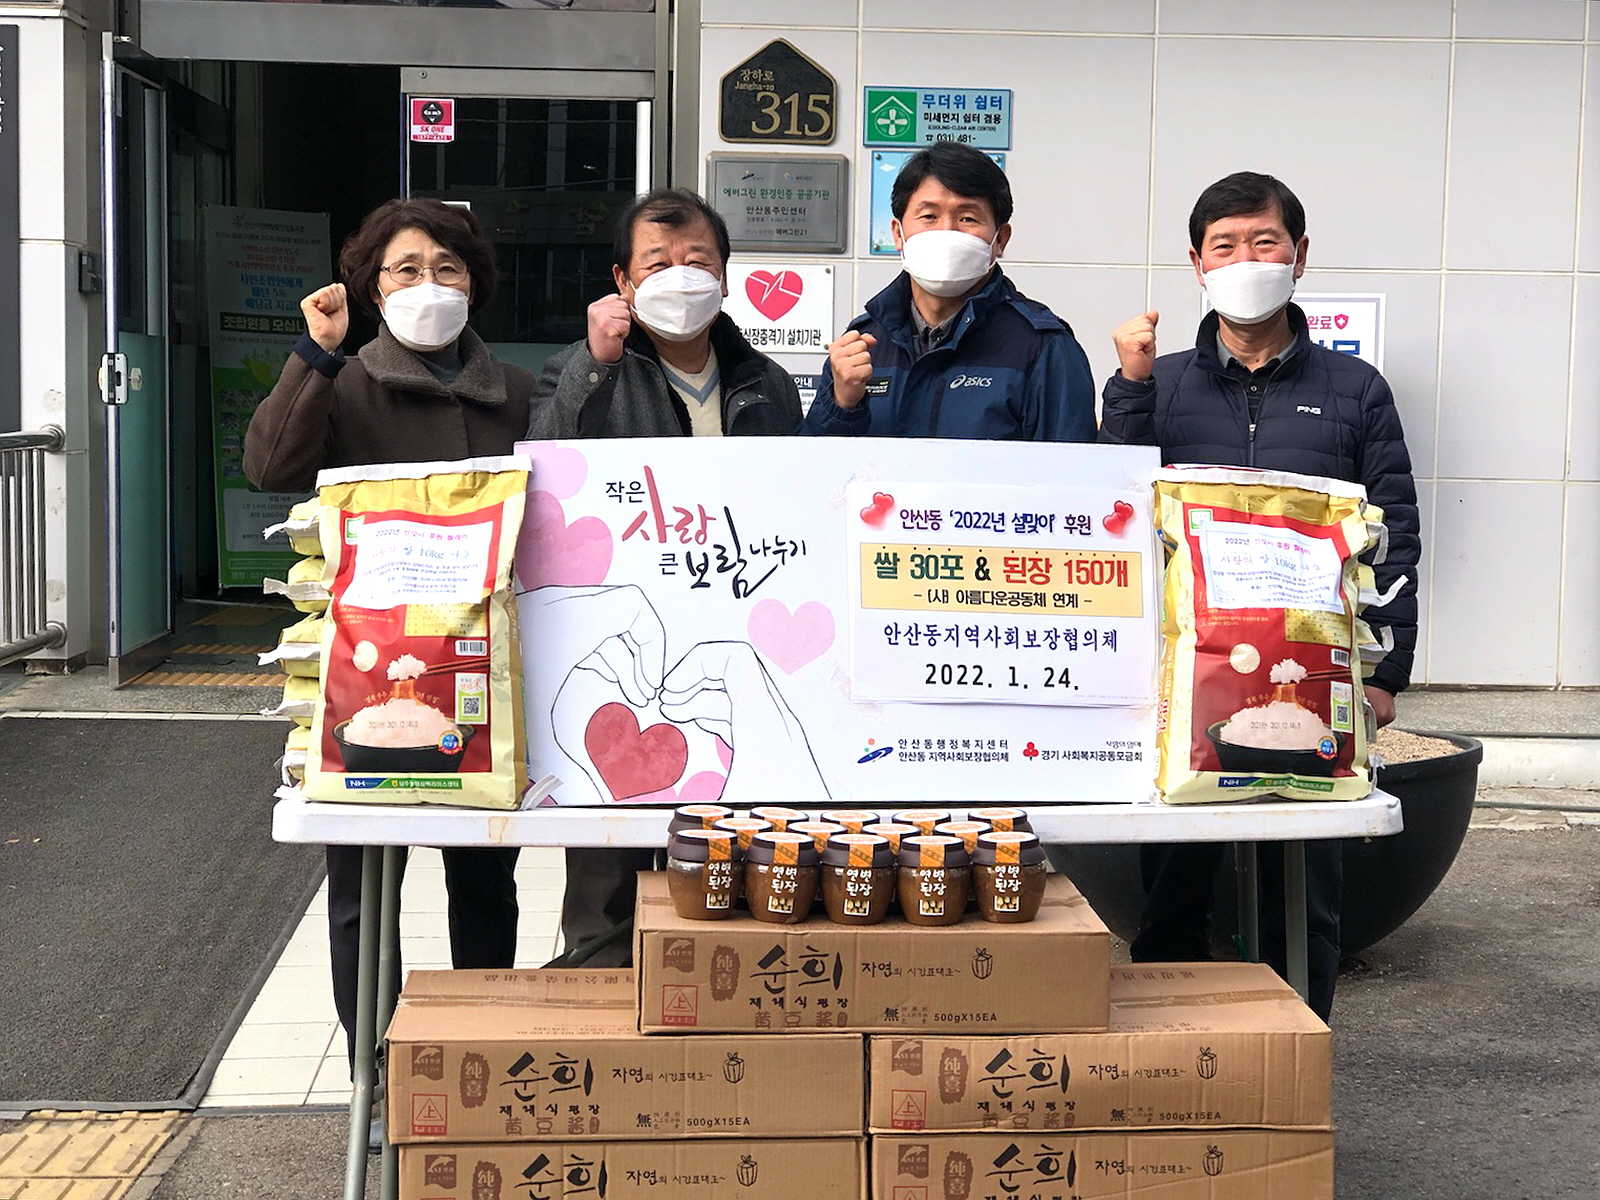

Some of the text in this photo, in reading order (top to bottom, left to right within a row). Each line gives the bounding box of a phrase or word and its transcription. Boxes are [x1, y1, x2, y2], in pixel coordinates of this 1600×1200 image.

[740, 69, 774, 82] 장하로
[922, 94, 1002, 110] 무더위 쉼터
[752, 92, 831, 136] 315
[924, 112, 1002, 124] 미세먼지 쉼터 겸용
[937, 133, 954, 142] 031)
[723, 188, 830, 200] 에버그린 환경인증 공공기관
[746, 206, 806, 216] 안산동주민센터
[224, 316, 270, 331] 조합원을
[788, 328, 822, 346] 설치기관
[606, 481, 645, 504] 작은
[622, 466, 716, 544] 사랑
[900, 509, 942, 531] 안산동
[1064, 514, 1092, 536] 후원
[420, 548, 444, 560] 10kg
[658, 553, 678, 575] 큰
[750, 535, 806, 566] 나누기
[874, 551, 1128, 588] 쌀 30포 & 된장 150개
[956, 590, 1046, 608] 아름다운공동체
[1053, 594, 1078, 608] 연계
[884, 622, 1118, 652] 안산동지역사회보장협의체
[925, 663, 1079, 690] 2022. 1. 24.
[898, 738, 1008, 750] 안산동행정복지센터
[898, 752, 1009, 762] 안산동 지역사회보장협의체
[1041, 750, 1142, 762] 경기 사회복지공동모금회
[708, 862, 732, 874] 연변
[772, 865, 798, 878] 연변
[846, 868, 872, 882] 연변
[920, 868, 946, 882] 연변
[994, 865, 1020, 878] 연변
[708, 876, 733, 890] 된장
[772, 878, 798, 894] 된장
[846, 882, 873, 897] 된장
[920, 882, 948, 897] 된장
[994, 878, 1022, 892] 된장
[749, 944, 844, 994] 순희
[862, 962, 902, 978] 자연의
[673, 996, 686, 1008] 上
[884, 1007, 899, 1022] 無
[934, 1012, 998, 1024] 500gX15EA
[499, 1052, 594, 1102] 순희
[612, 1066, 653, 1084] 자연의
[978, 1048, 1071, 1099] 순희
[1088, 1064, 1129, 1080] 자연의
[424, 1106, 436, 1118] 上
[902, 1101, 916, 1113] 上
[636, 1113, 652, 1128] 無
[686, 1117, 750, 1128] 500gX15EA
[1110, 1108, 1125, 1122] 無
[1160, 1112, 1222, 1122] 500gX15EA
[984, 1143, 1076, 1192] 순희
[1095, 1159, 1134, 1176] 자연의
[626, 1170, 667, 1186] 자연의
